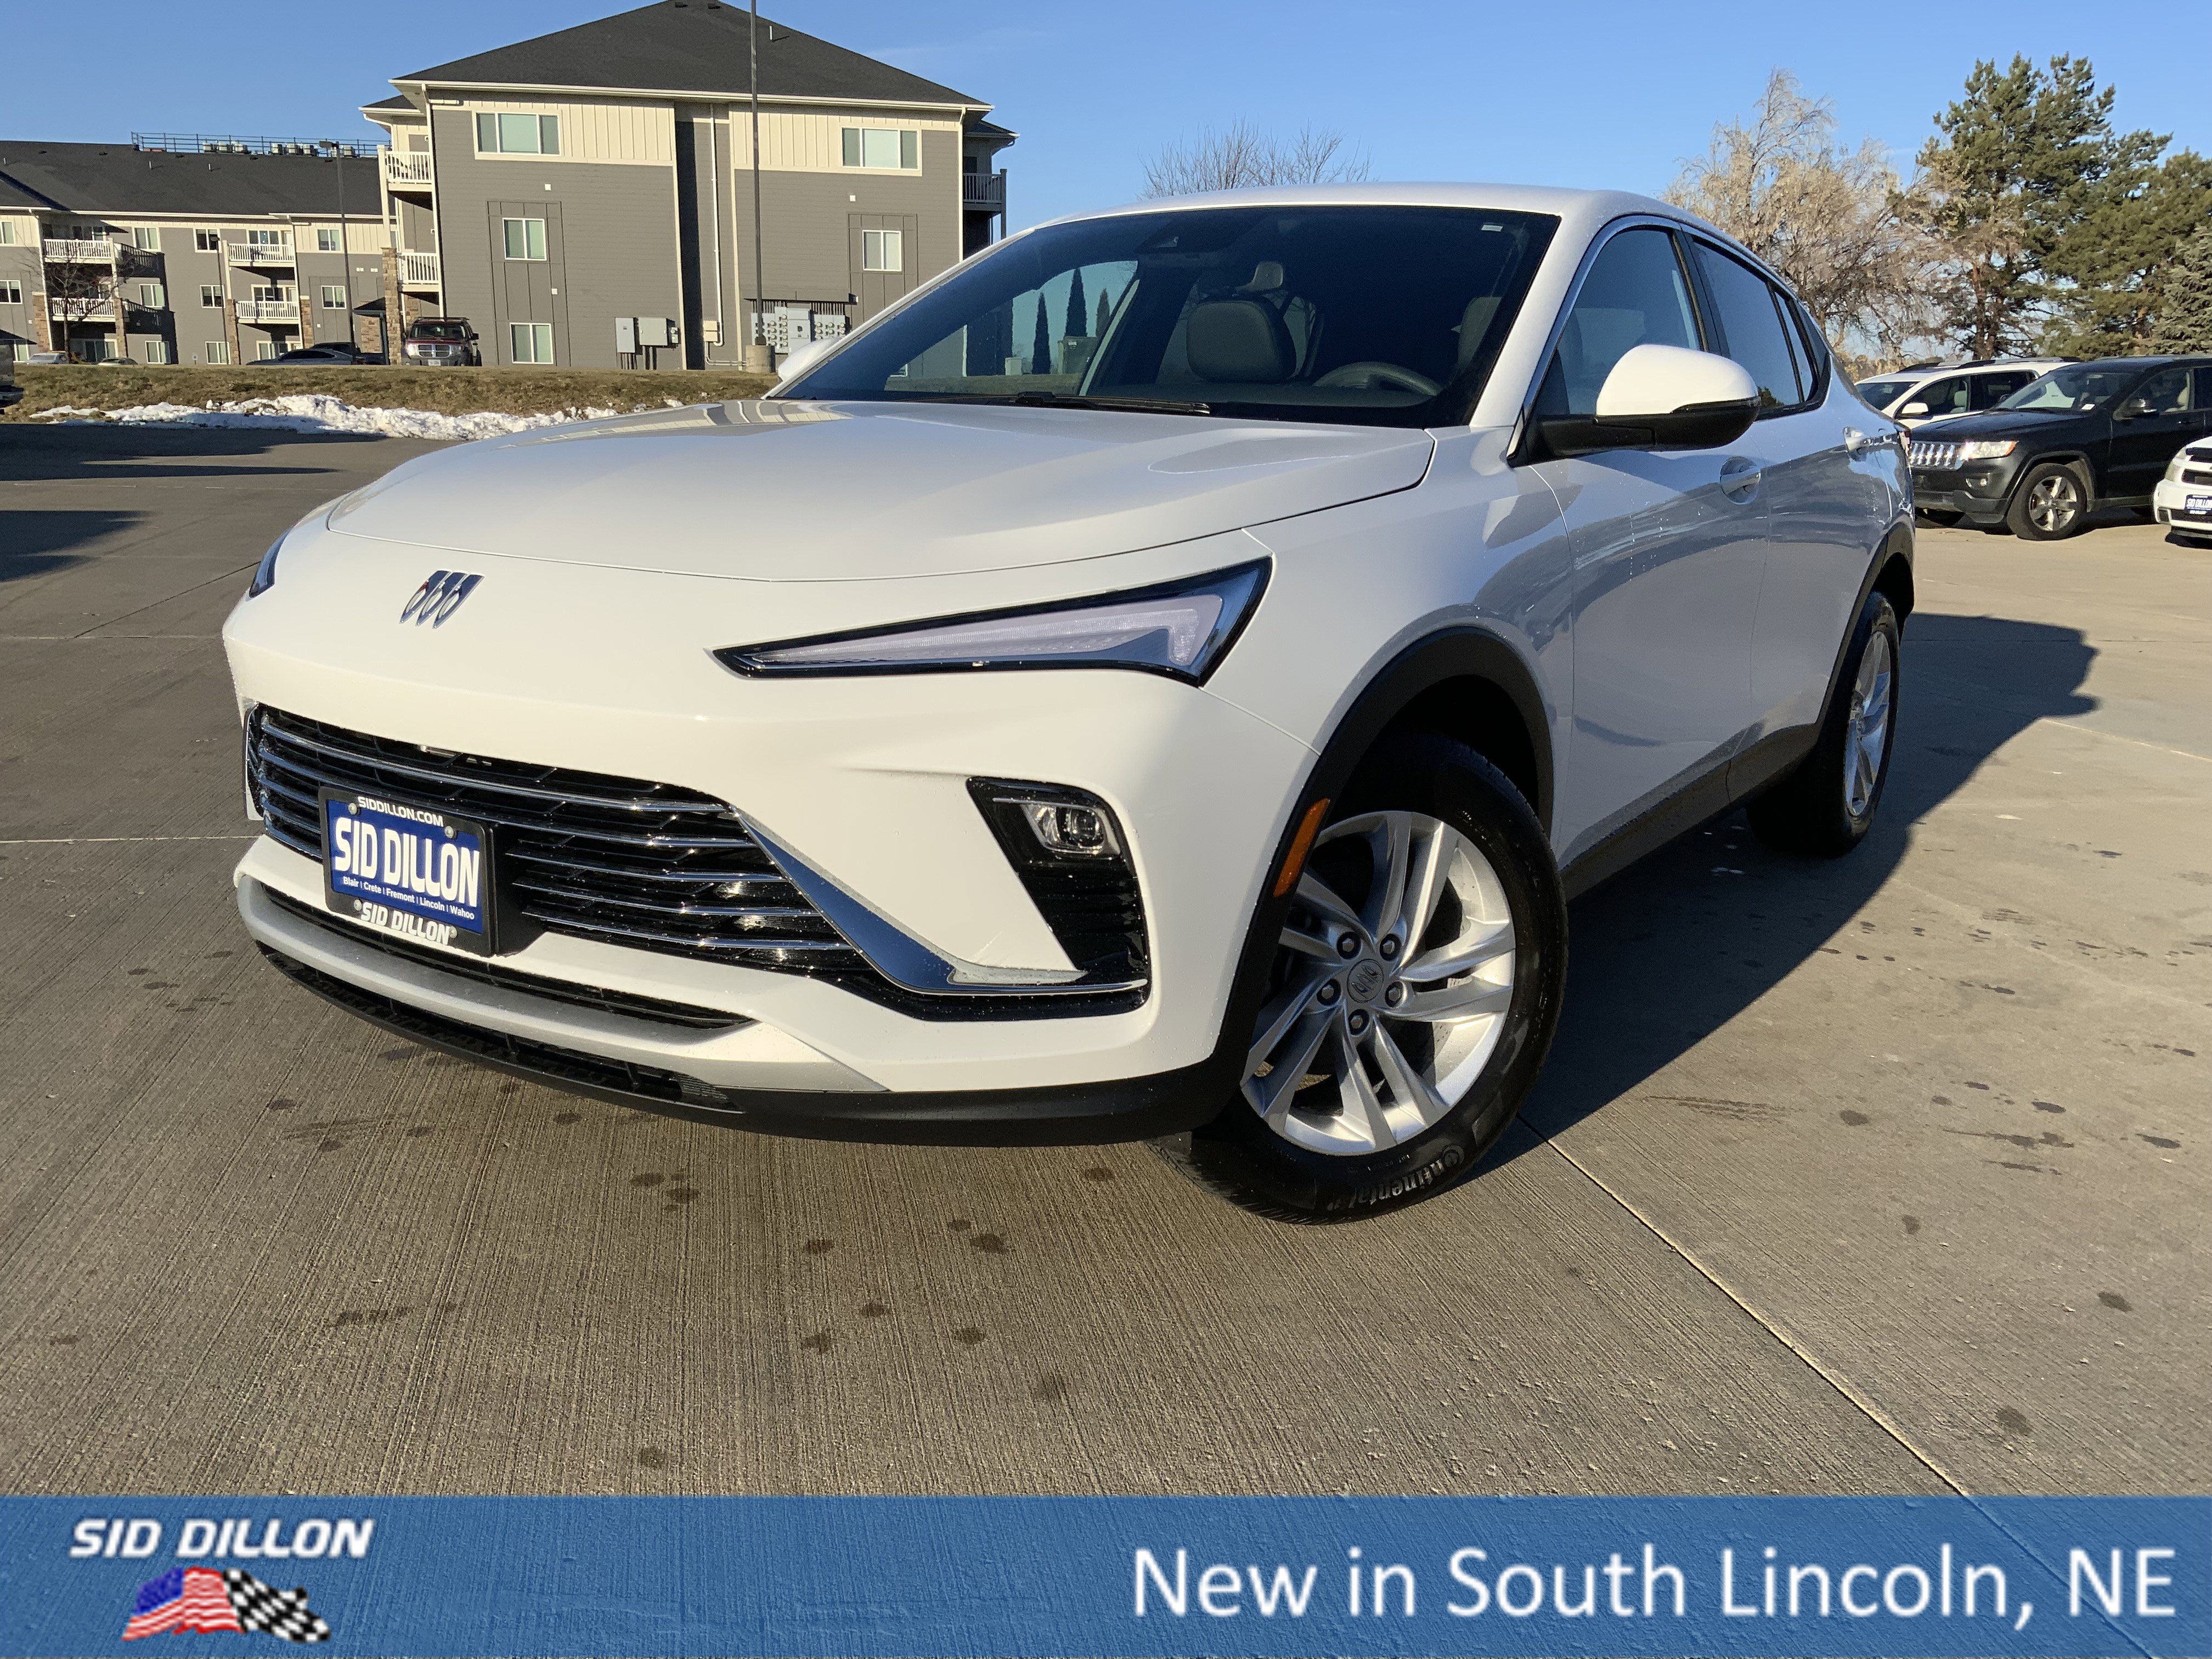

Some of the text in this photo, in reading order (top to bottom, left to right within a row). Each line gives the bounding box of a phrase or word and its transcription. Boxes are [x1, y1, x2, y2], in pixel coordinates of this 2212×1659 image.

[358, 796, 444, 827] SIDDILLON.COM
[335, 817, 480, 907] SID DILLON
[343, 876, 475, 920] Blair Crete Fremont Lincoln Wahoo
[360, 901, 451, 945] SID DILLON
